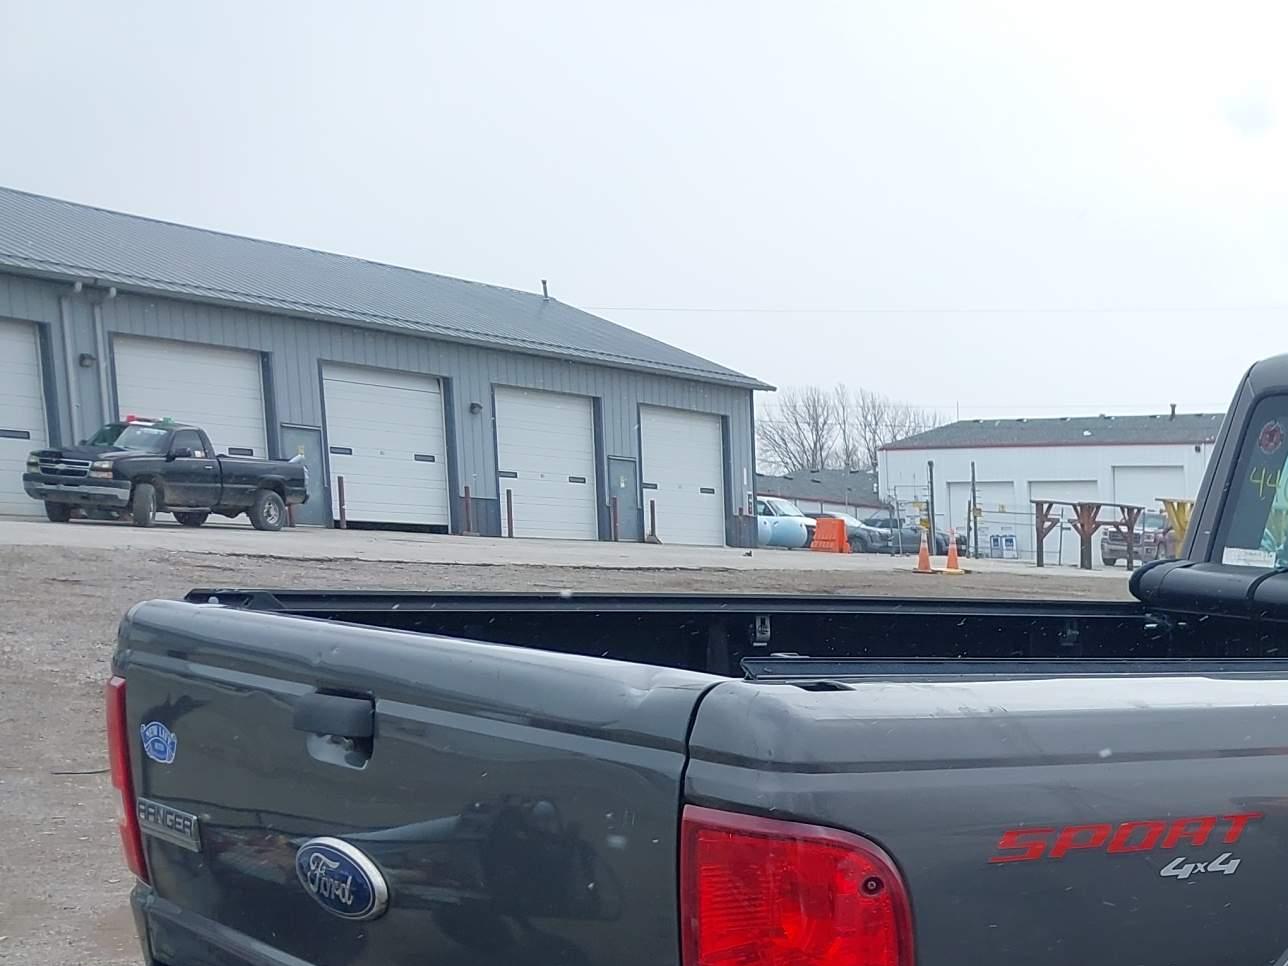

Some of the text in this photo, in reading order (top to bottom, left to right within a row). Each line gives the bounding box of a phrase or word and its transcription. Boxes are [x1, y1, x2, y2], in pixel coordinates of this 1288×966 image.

[137, 801, 193, 839] RANGER
[988, 811, 1264, 864] SPORT
[306, 852, 354, 905] Ford
[1160, 852, 1241, 880] 4x4
